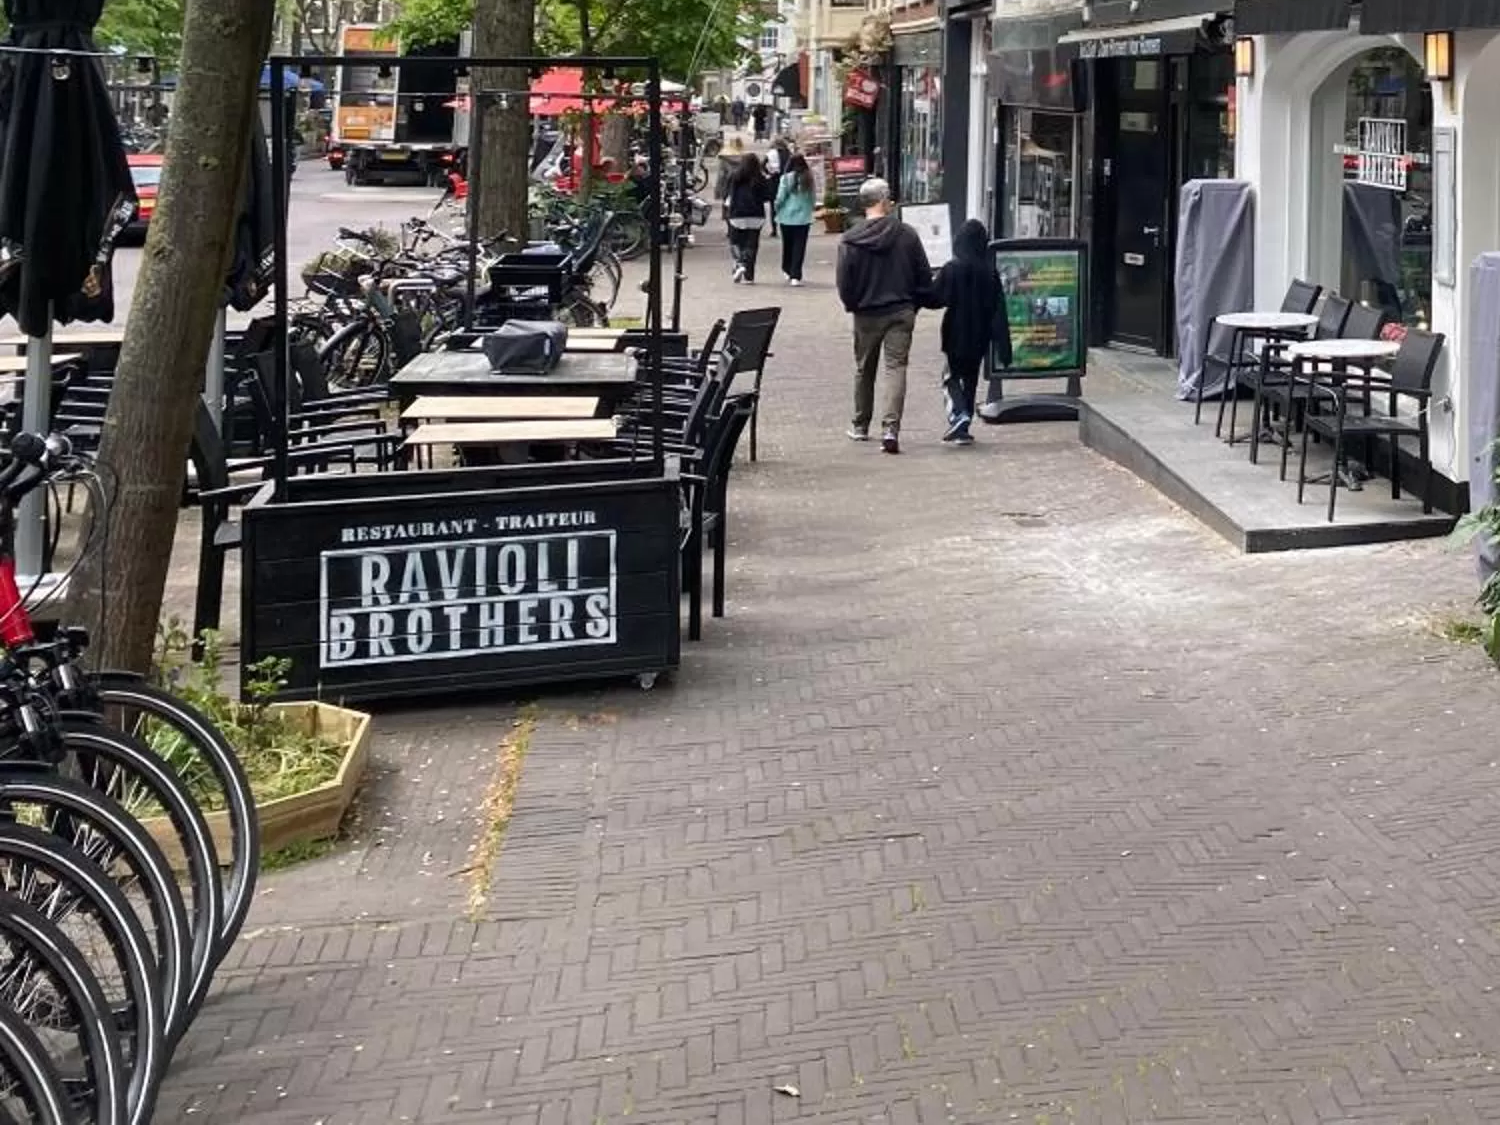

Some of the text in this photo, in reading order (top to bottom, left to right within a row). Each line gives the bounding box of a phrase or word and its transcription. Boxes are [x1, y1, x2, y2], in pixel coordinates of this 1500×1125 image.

[341, 519, 477, 542] RESTAURANT
[496, 511, 597, 530] TRAITEUR
[361, 539, 579, 607] RAVIOLI
[329, 593, 610, 661] BROTHERS
